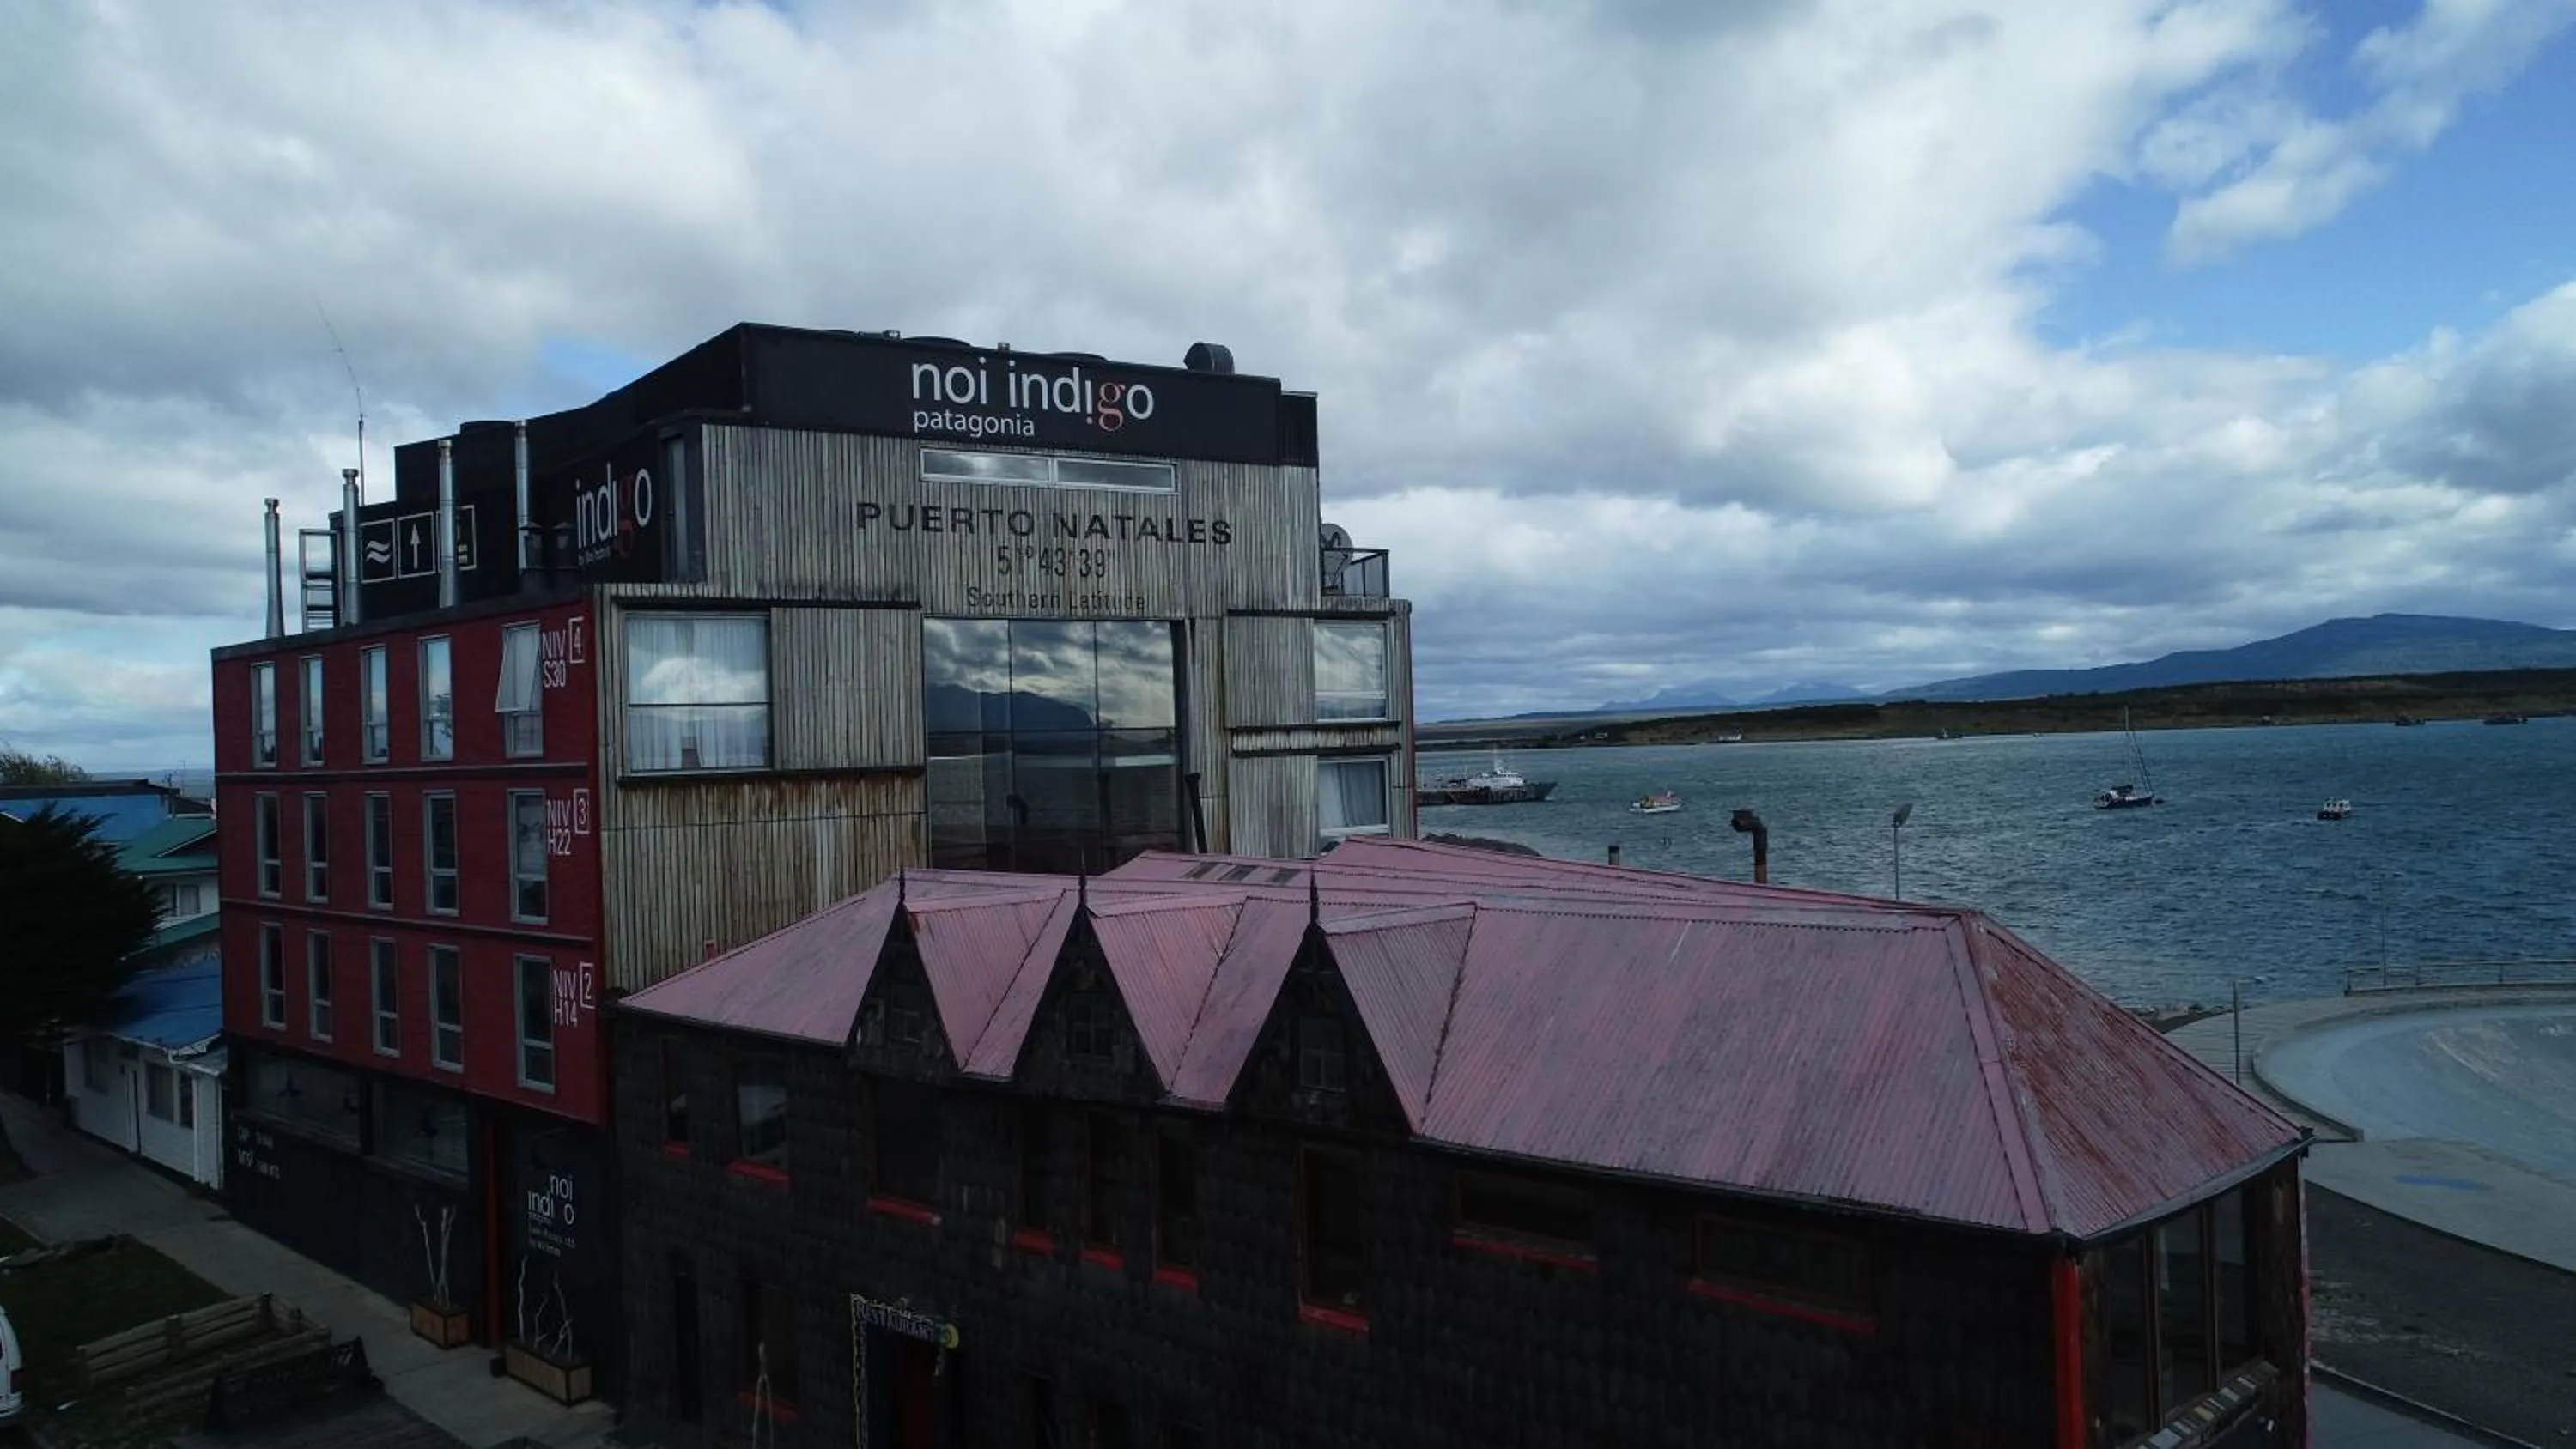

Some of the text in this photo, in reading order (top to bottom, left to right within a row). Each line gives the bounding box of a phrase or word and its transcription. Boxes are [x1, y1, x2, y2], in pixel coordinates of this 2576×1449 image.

[912, 357, 1154, 431] noi indigo
[914, 409, 1035, 438] patagonia
[858, 503, 1232, 545] PUERTO NATALES
[967, 586, 1061, 609] Southern
[542, 629, 567, 661] NIV
[543, 661, 567, 688] S30
[546, 799, 572, 828] NIV
[547, 829, 572, 856] H22
[552, 969, 577, 999] NIV
[554, 998, 578, 1028] H14
[550, 1173, 574, 1202] noi
[527, 1190, 575, 1226] indio
